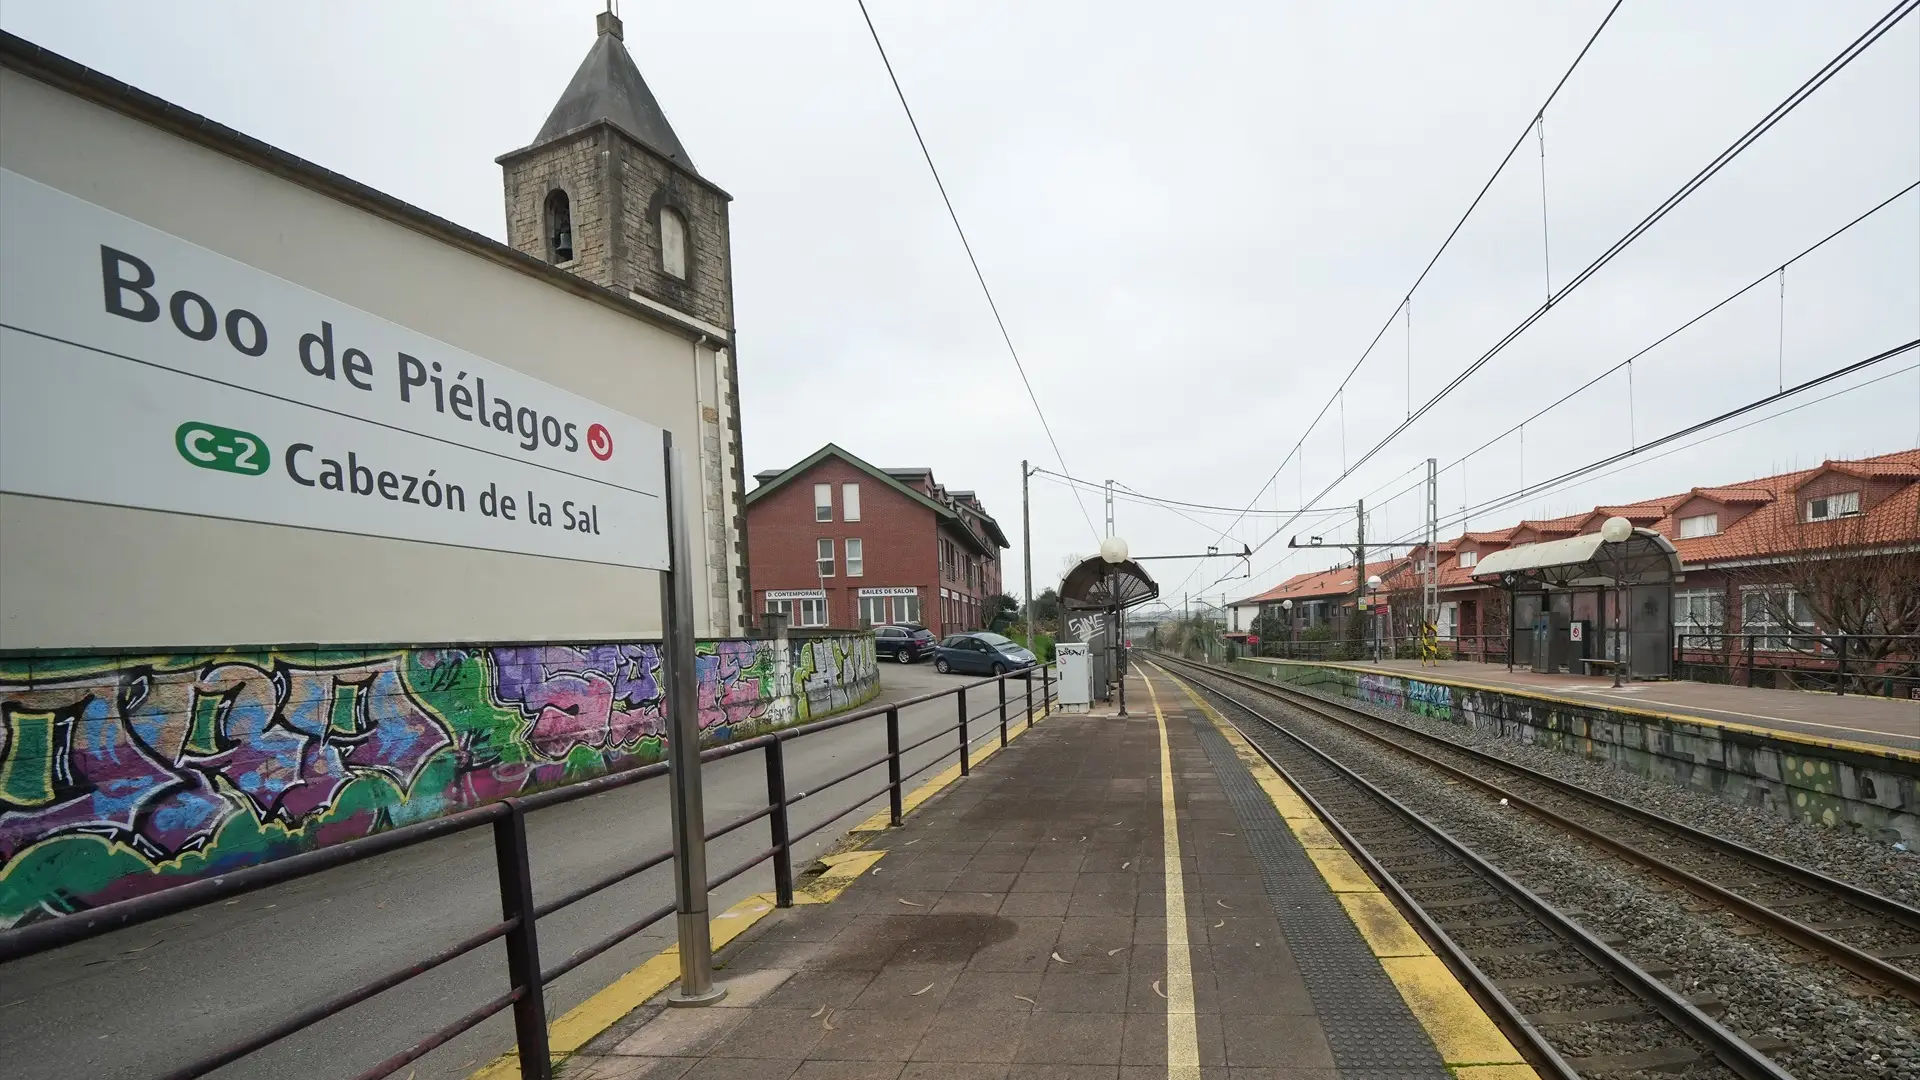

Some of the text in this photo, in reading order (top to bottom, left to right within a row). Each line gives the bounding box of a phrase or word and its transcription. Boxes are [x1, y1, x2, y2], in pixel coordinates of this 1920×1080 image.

[100, 243, 579, 452] Boo de Piélagos
[184, 429, 259, 470] C-2
[285, 442, 600, 535] Cabezón de la Sal
[893, 587, 914, 595] SALÓN
